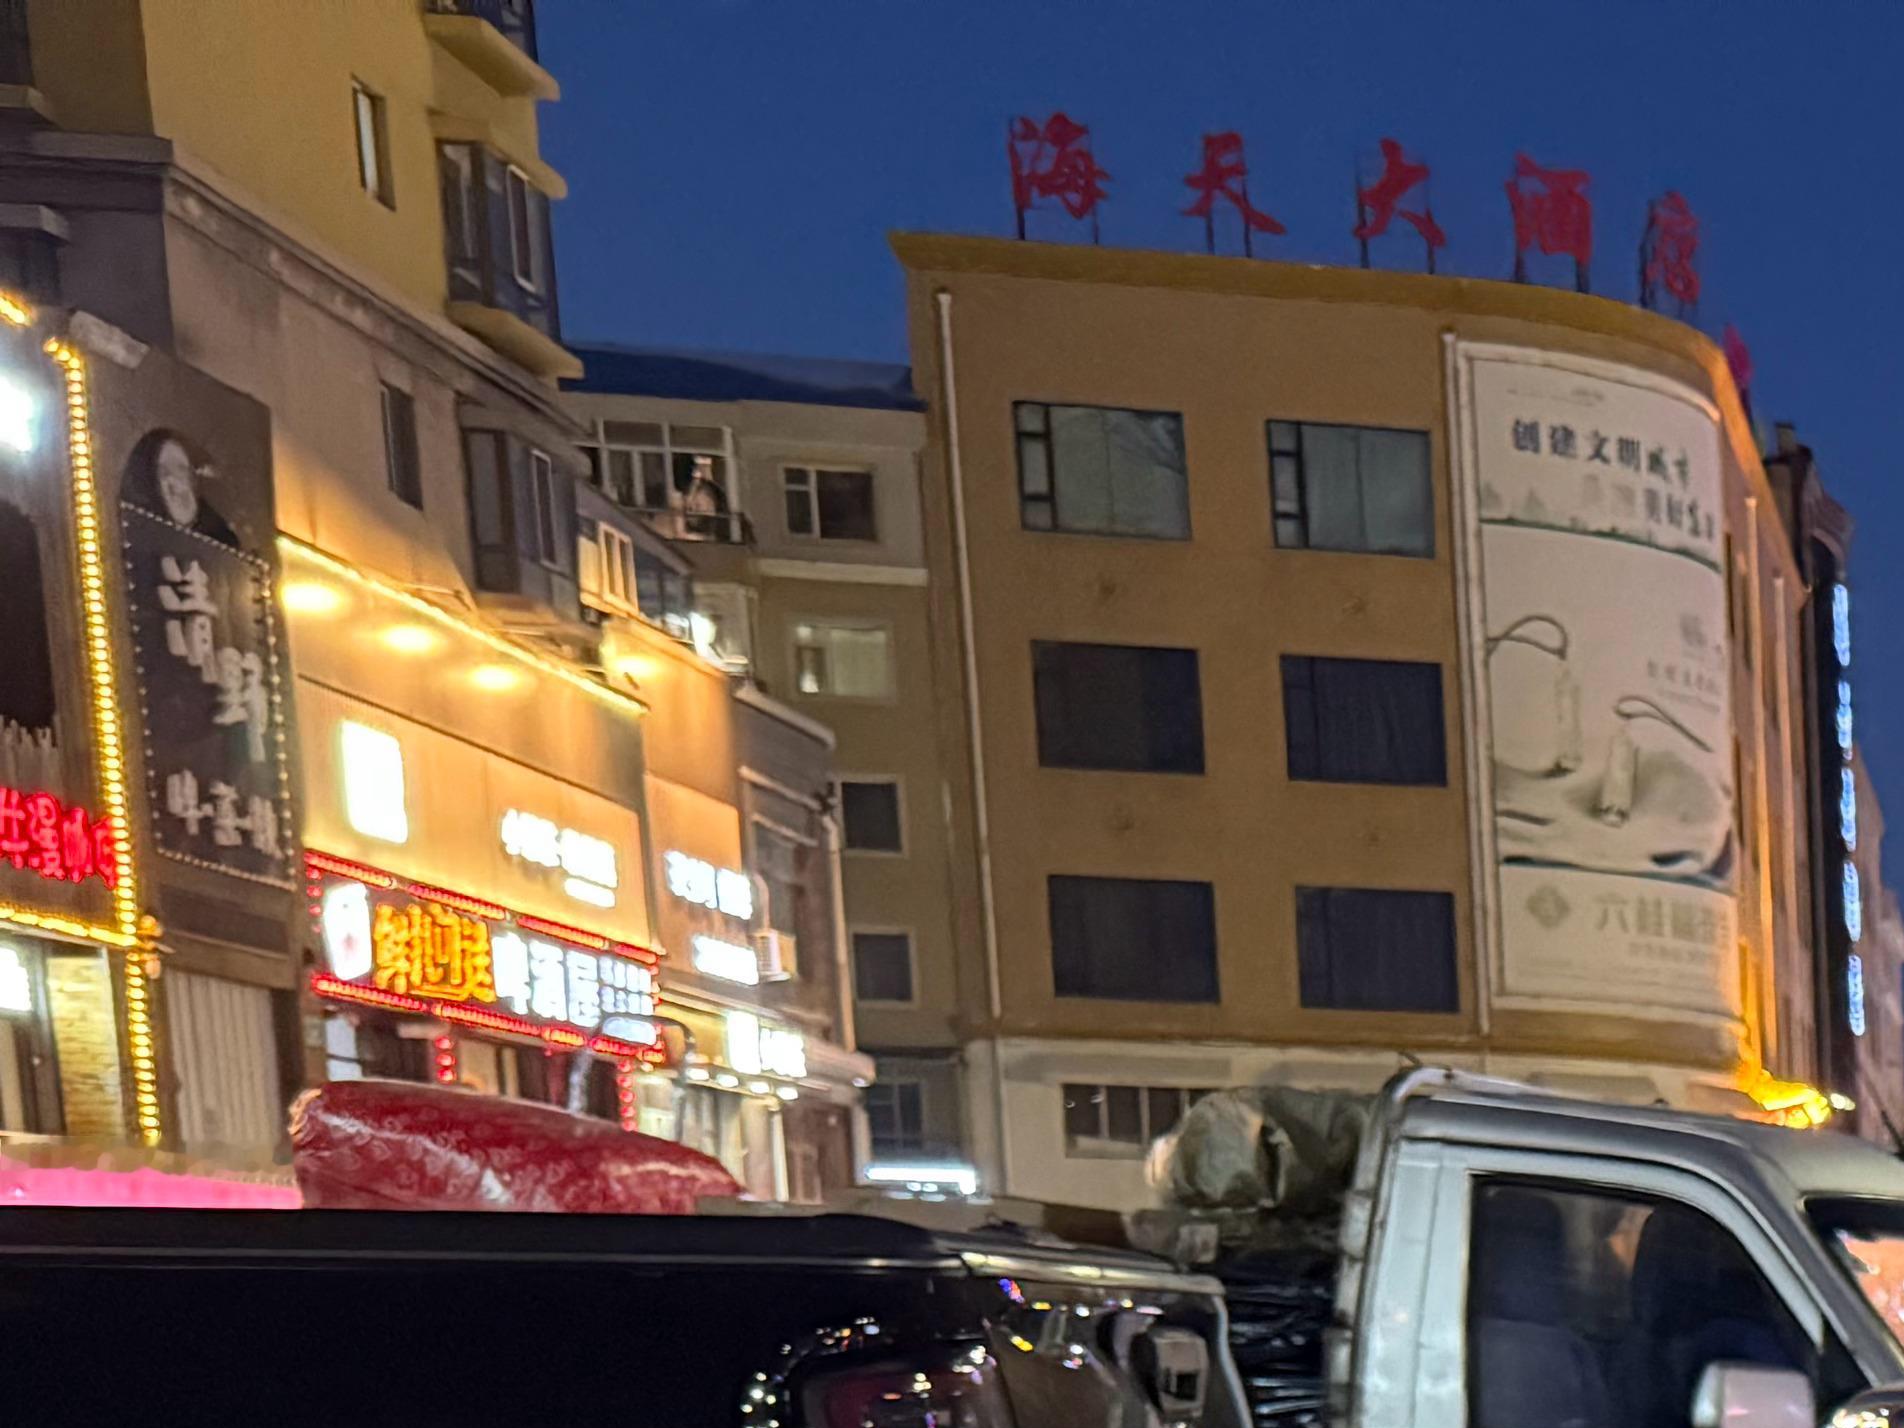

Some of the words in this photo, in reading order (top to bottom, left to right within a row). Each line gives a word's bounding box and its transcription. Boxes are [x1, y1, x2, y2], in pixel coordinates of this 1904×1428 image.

[1008, 112, 1698, 302] 海天大酒店
